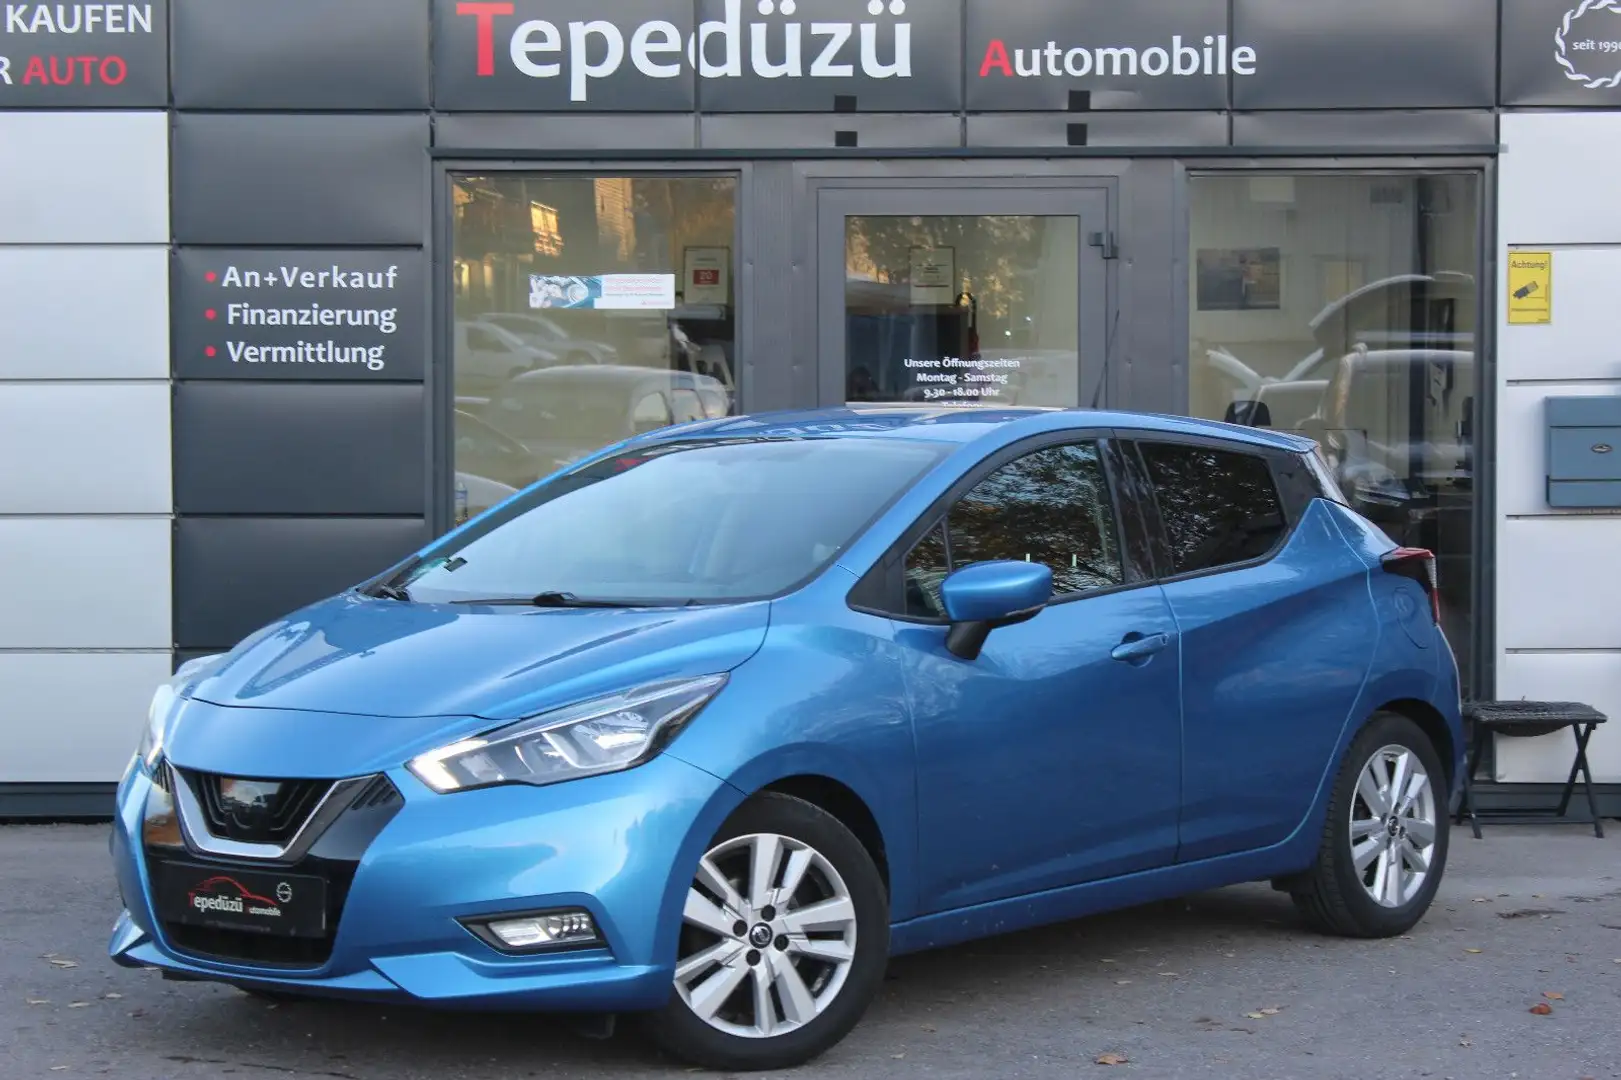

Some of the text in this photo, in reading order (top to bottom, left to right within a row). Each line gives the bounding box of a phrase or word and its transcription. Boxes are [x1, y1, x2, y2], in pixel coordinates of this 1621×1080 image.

[6, 4, 152, 33] KAUFEN
[456, 0, 912, 101] Tepedüzü
[980, 35, 1257, 77] Automobile
[1572, 39, 1596, 50] seit
[22, 55, 127, 86] AUTO
[222, 266, 398, 288] An+Verkauf
[227, 303, 398, 333] Finanzierung
[226, 340, 385, 371] Vermittlung
[904, 356, 1020, 370] Unsere Öffnungszeiten
[916, 373, 957, 384] Montag
[964, 373, 1008, 384] Samstag
[924, 388, 946, 398] 9.30
[953, 387, 980, 396] 18.00
[981, 387, 1000, 397] Uhr
